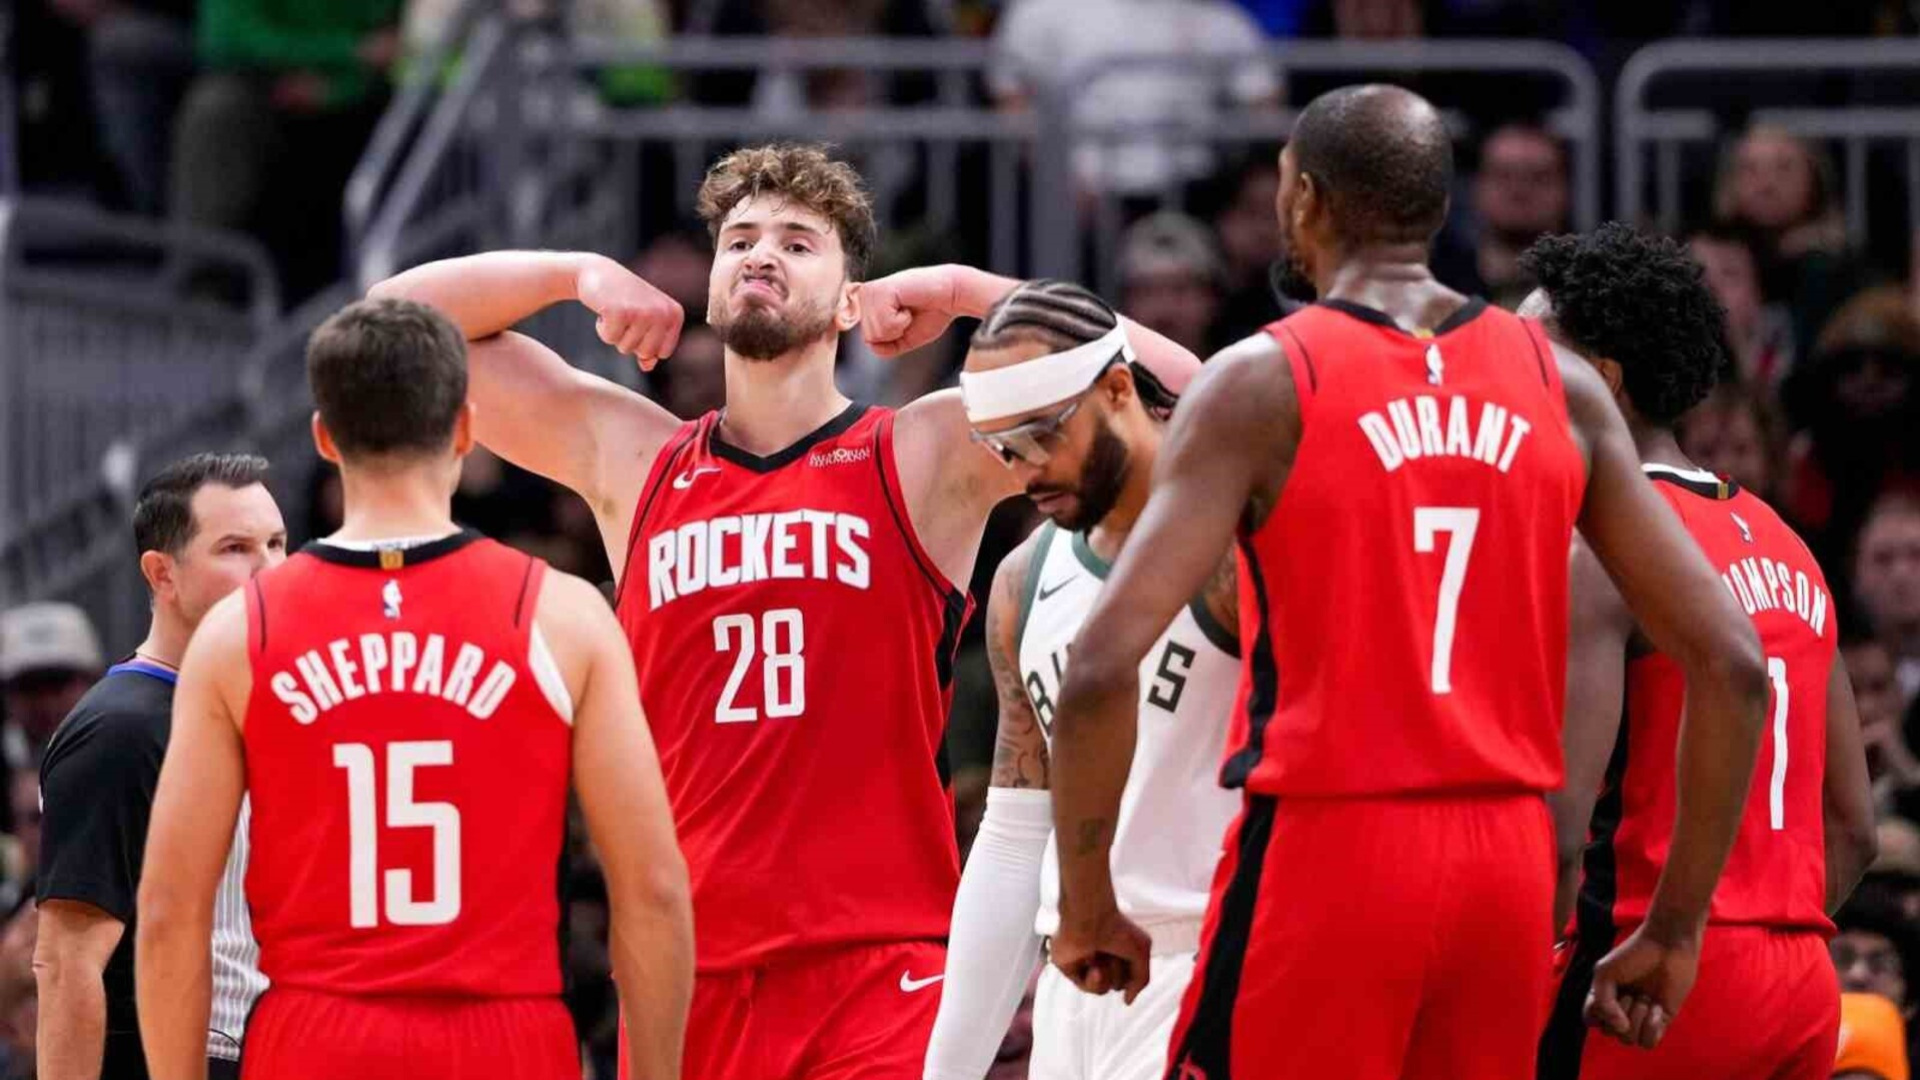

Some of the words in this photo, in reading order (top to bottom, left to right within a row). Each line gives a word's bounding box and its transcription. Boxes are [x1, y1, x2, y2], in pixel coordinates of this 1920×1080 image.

[1358, 395, 1531, 472] DURANT
[648, 509, 870, 609] ROCKETS
[1413, 506, 1480, 694] 7
[1721, 556, 1827, 637] OMPSON
[271, 632, 516, 723] SHEPPARD
[713, 608, 805, 723] 28
[333, 740, 461, 928] 15
